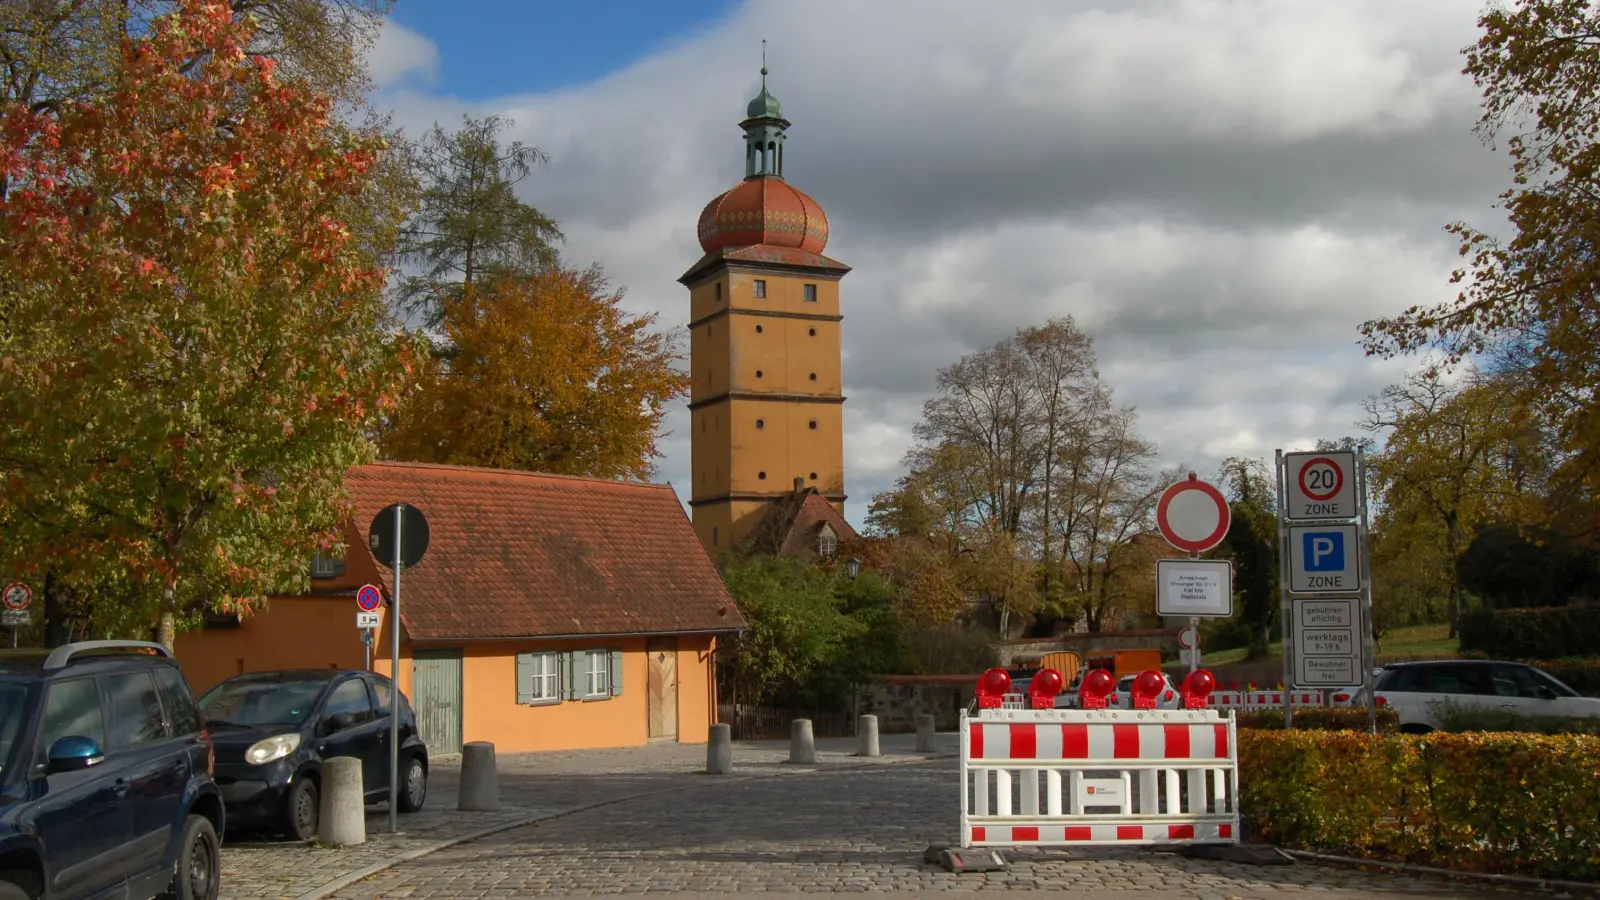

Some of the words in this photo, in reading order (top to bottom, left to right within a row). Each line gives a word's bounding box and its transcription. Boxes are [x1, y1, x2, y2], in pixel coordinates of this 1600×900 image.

[1308, 469, 1334, 489] 20
[1305, 503, 1339, 515] ZONE
[1312, 537, 1334, 567] P
[1308, 576, 1342, 588] ZONE
[1306, 605, 1347, 615] gebühren-
[1311, 614, 1342, 623] pflichtig
[1306, 633, 1348, 642] werktags
[1314, 642, 1333, 651] 9-19
[1335, 642, 1340, 651] h
[1308, 660, 1347, 668] Bewohner
[1321, 672, 1335, 680] frei
